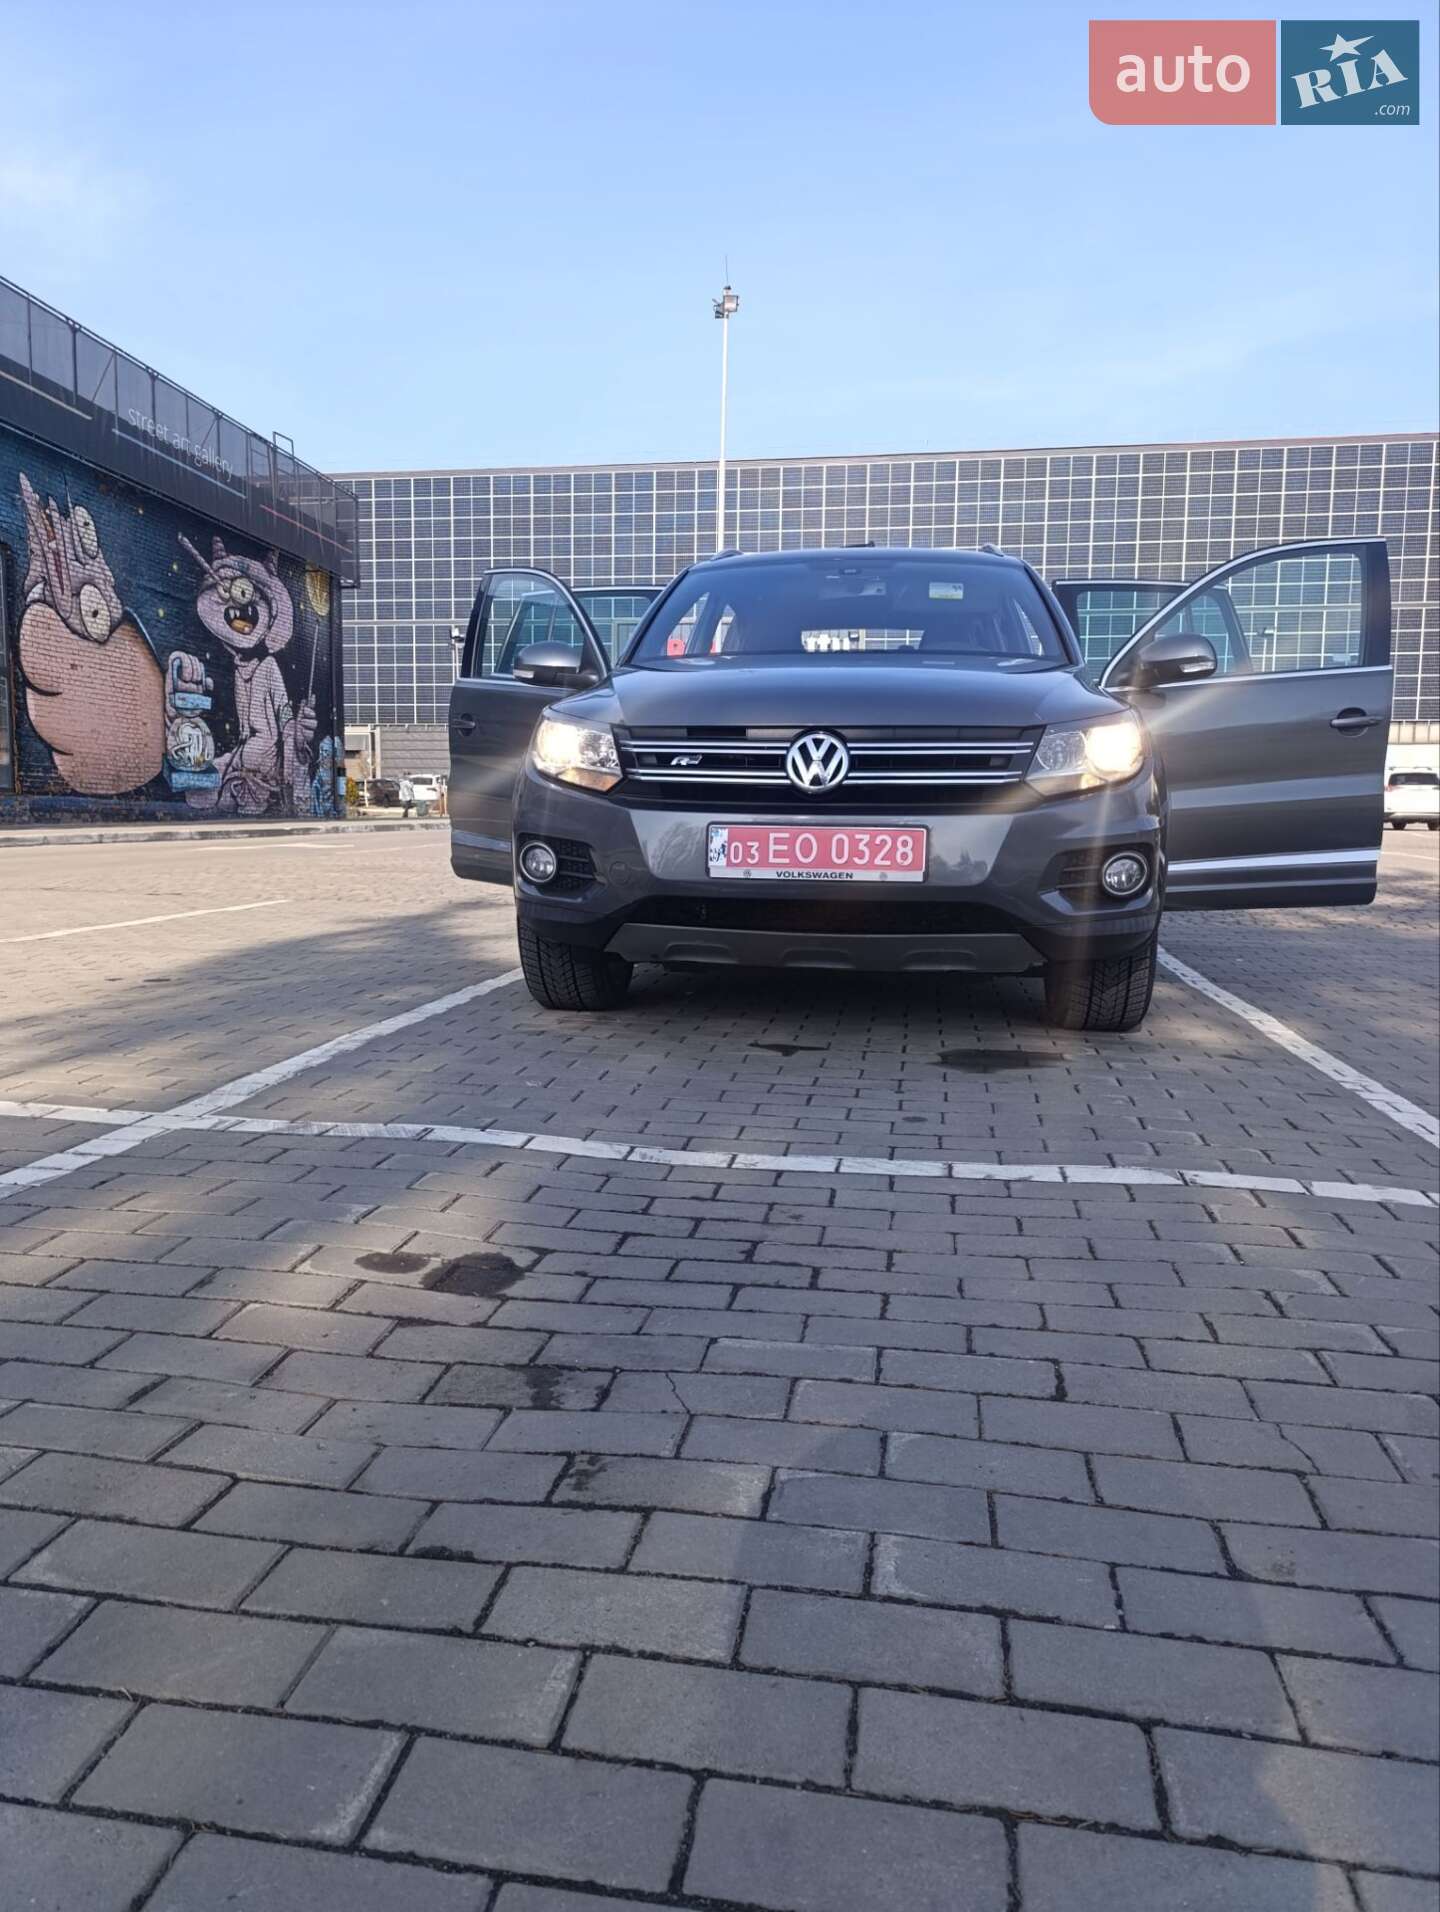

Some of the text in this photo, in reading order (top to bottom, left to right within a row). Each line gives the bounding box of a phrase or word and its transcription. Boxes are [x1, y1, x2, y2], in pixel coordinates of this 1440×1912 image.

[194, 444, 233, 482] gallery
[730, 841, 760, 865] 03
[831, 833, 914, 866] 0328
[775, 870, 854, 880] VOLKSWAGEN
